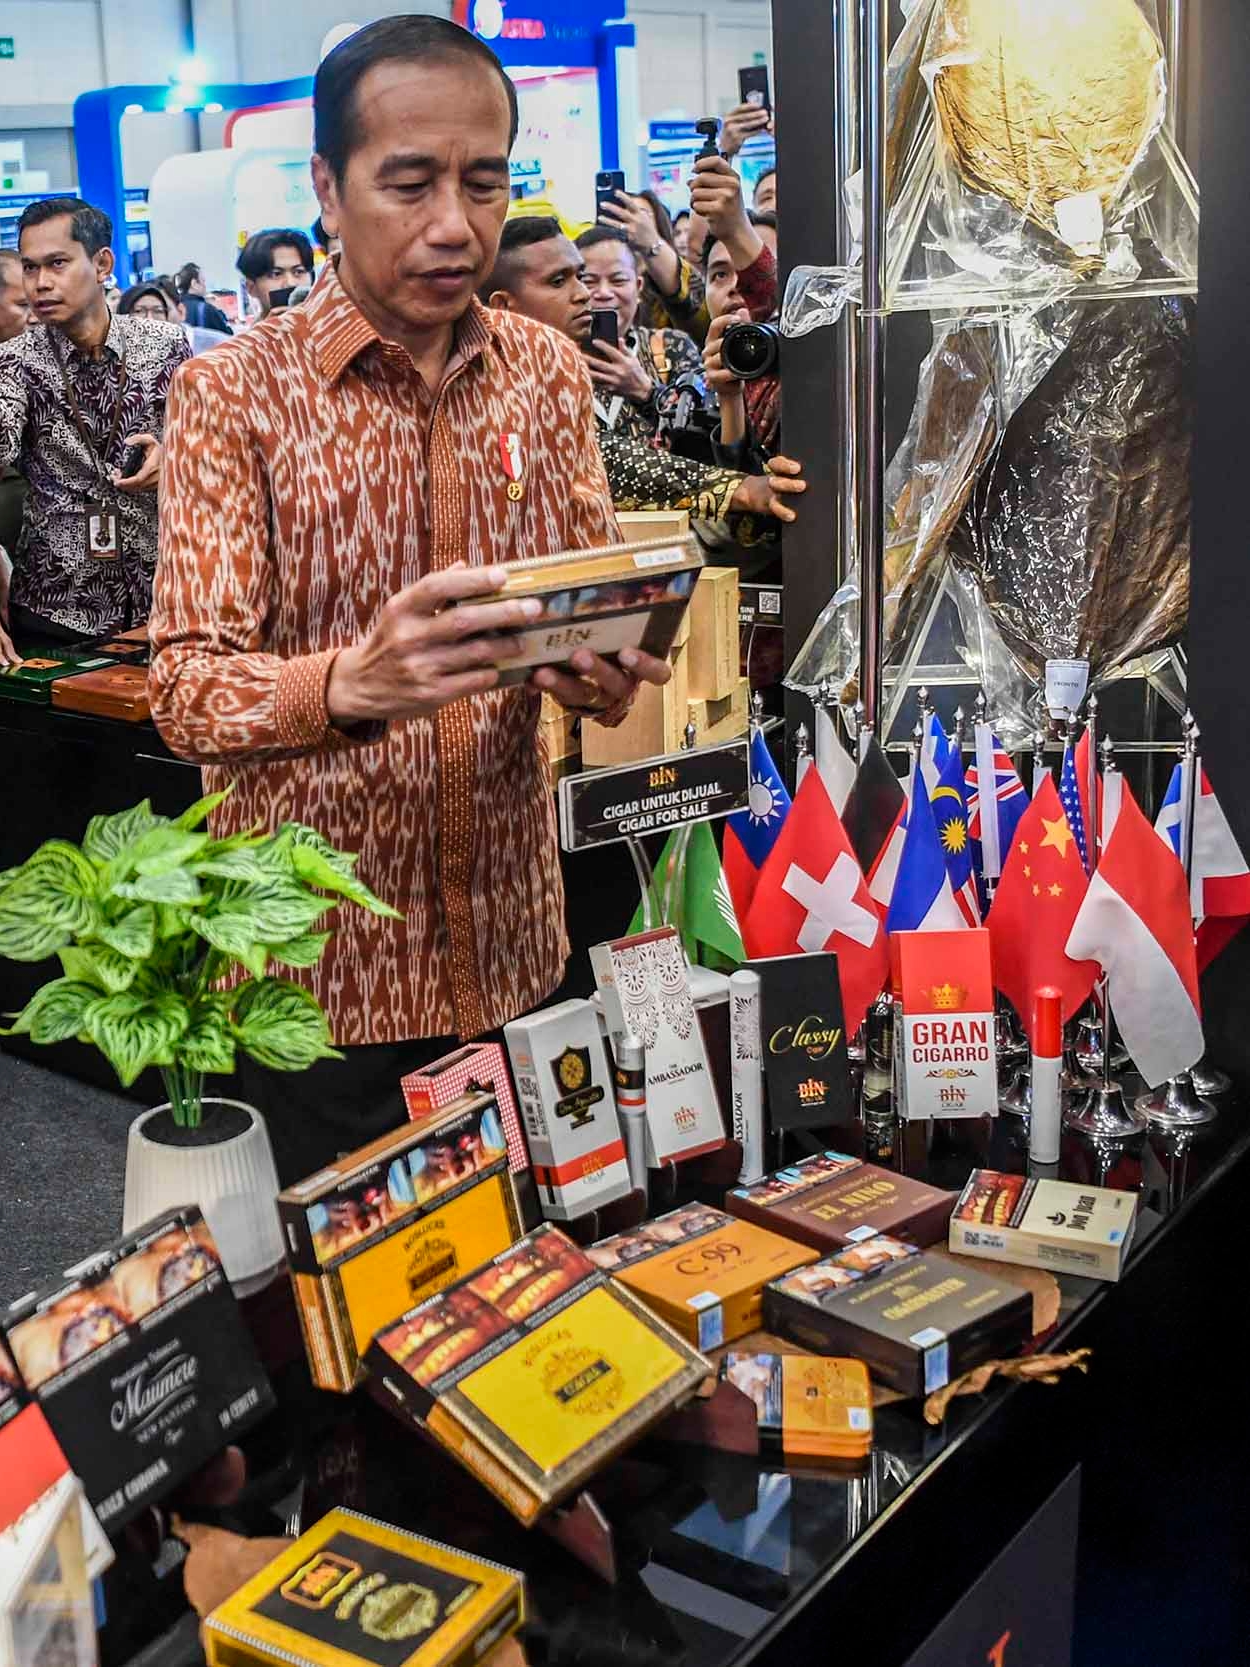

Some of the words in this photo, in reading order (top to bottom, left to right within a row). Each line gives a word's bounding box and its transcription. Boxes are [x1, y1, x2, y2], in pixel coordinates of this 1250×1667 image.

[650, 766, 676, 787] BIN
[603, 801, 640, 820] CIGAR
[641, 790, 681, 811] UNTUK
[681, 782, 722, 801] DIJUAL
[618, 816, 655, 833] CIGAR
[656, 809, 679, 825] FOR
[680, 802, 709, 818] SALE
[768, 1015, 842, 1061] Classy
[912, 1021, 988, 1046] GRAN
[913, 1046, 989, 1064] CIGARRO
[647, 1062, 703, 1087] AMBASSADOR
[797, 1077, 826, 1098] BIN
[940, 1085, 966, 1102] BIN
